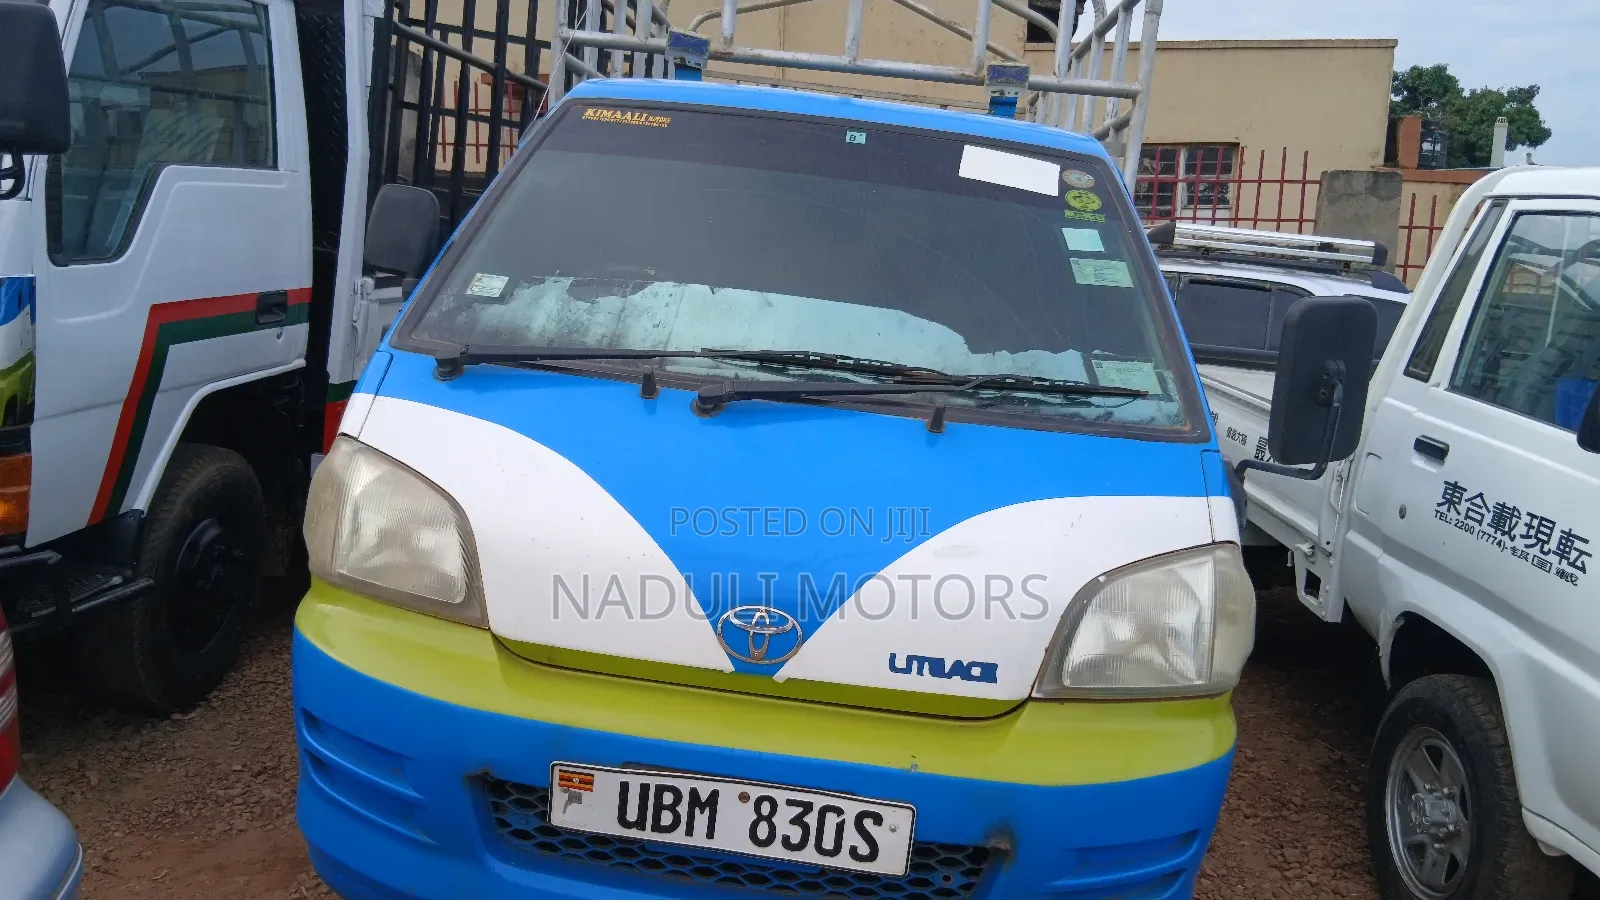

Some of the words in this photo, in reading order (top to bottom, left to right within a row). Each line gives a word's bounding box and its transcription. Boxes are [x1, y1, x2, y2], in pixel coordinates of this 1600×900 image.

[583, 108, 649, 122] KIMAALI
[1434, 508, 1453, 525] TEL:
[1453, 518, 1475, 535] 2200
[616, 780, 721, 840] UBM
[748, 794, 884, 863] 830S
